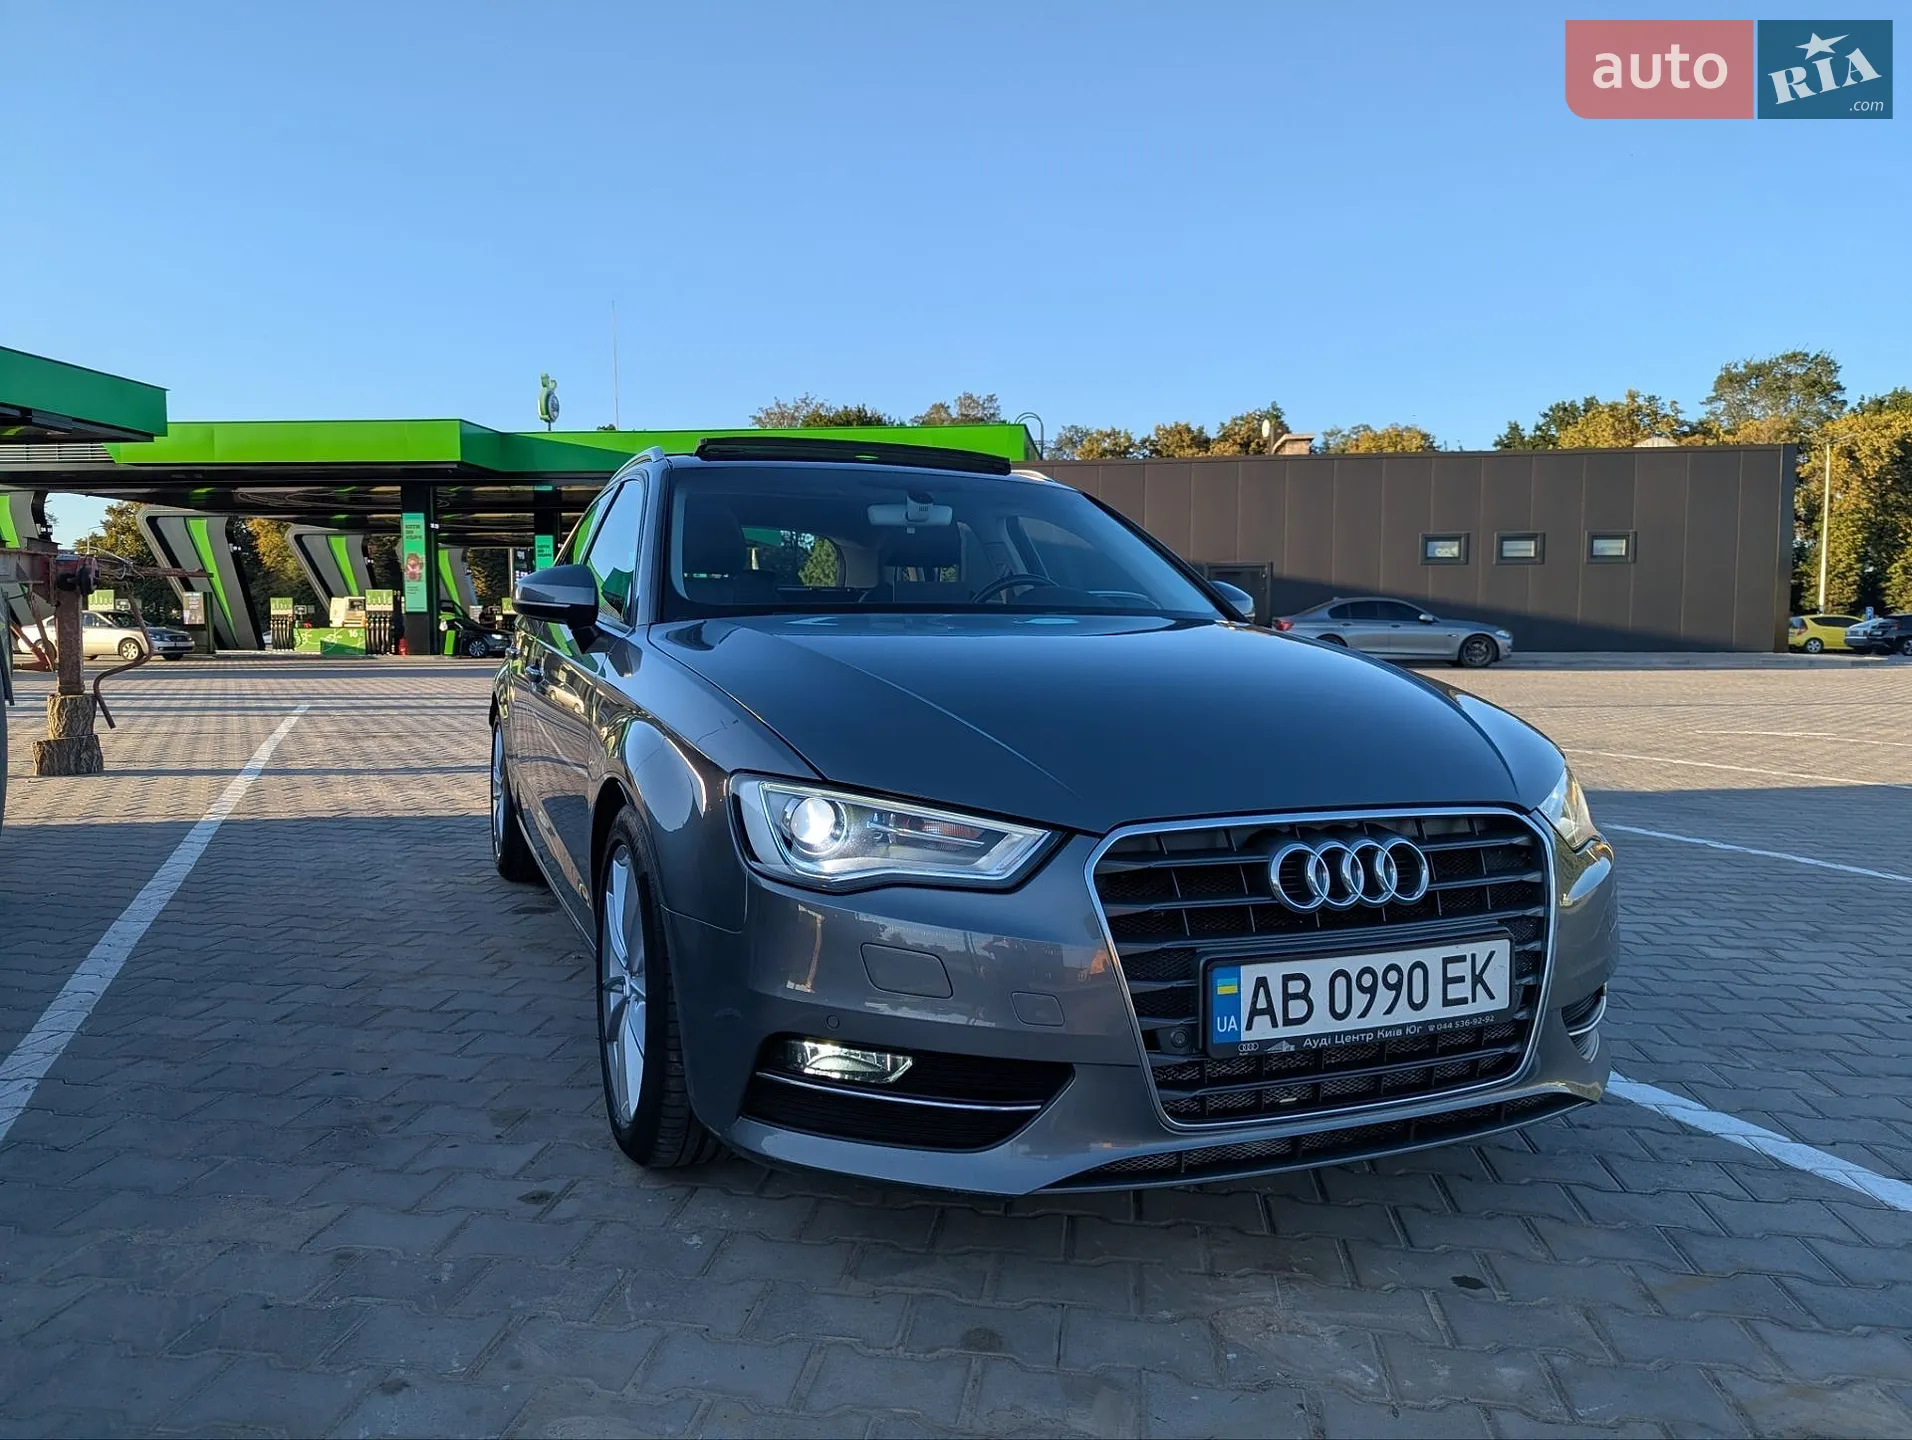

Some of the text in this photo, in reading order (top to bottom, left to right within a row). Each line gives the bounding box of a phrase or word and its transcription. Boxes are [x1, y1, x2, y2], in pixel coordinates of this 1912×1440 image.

[1245, 949, 1497, 1031] AB 0990 EK
[1216, 1014, 1239, 1033] UA
[1303, 1014, 1496, 1049] Ауді Центр Київ Юг 044 536-92-92
